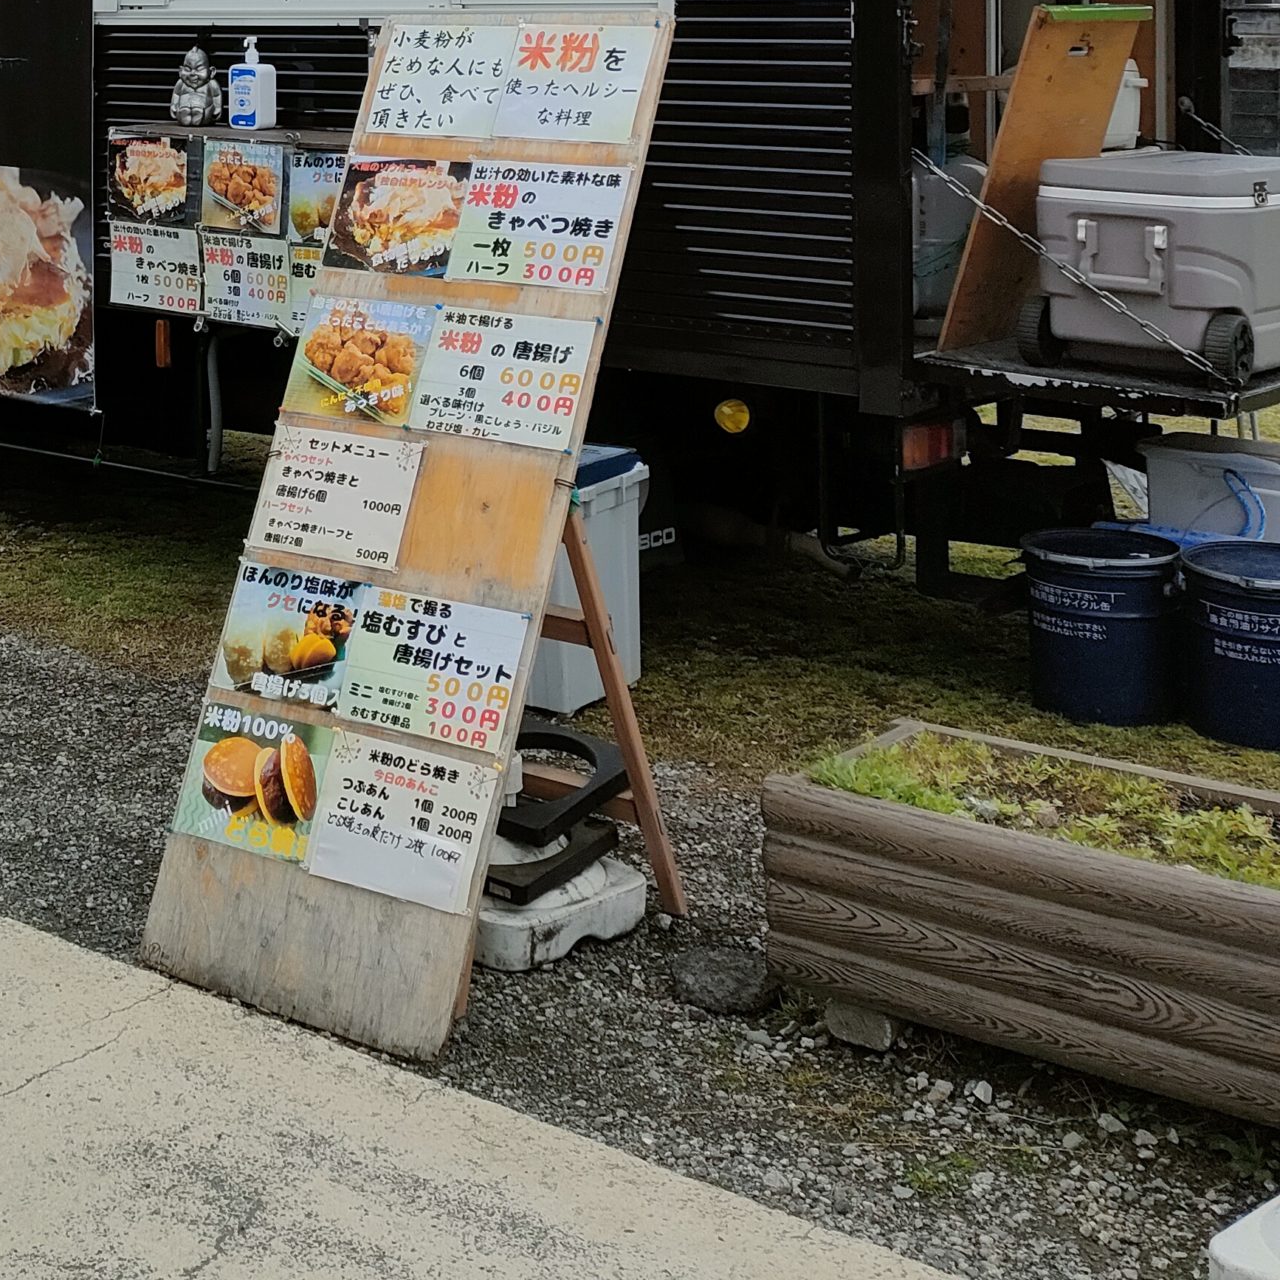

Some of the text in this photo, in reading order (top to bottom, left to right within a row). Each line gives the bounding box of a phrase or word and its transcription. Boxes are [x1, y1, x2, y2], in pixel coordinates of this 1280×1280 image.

[393, 29, 475, 49] 小麦粉が
[517, 31, 628, 73] 米粉を
[384, 56, 503, 78] だめな人にも
[505, 78, 638, 98] 使ったヘルシー
[371, 108, 454, 129] 頂きたい
[537, 107, 593, 127] な料理
[474, 166, 622, 188] 出汁の効いた素朴な味
[466, 182, 537, 209] 米粉の
[487, 210, 615, 239] きゃべつ焼き
[112, 234, 155, 255] 米粉の
[473, 238, 605, 266] 一枚 500円
[135, 257, 198, 277] きゃべつ焼き
[205, 246, 284, 271] 米粉の唐揚げ
[136, 274, 199, 293] 1枚 500円
[223, 269, 288, 291] 6個 600円
[466, 261, 596, 287] ハーフ 300円
[127, 291, 197, 311] ハーフ 300円
[227, 285, 286, 304] 3個 400円
[443, 311, 514, 330] 米油で揚げる
[437, 329, 574, 364] 米粉の唐揚げ
[459, 365, 582, 396] 6個 600円
[420, 394, 485, 413] 選べる味付け
[457, 386, 575, 417] 3個 400円
[425, 420, 501, 438] わさび塩・カレー
[309, 438, 390, 459] セットメニュー
[281, 465, 360, 488] きゃべつ焼きと
[261, 500, 313, 516] ハーフセット
[275, 484, 402, 516] 唐揚げ6個 1000円
[268, 517, 354, 541] きゃべつ焼きハーフと
[263, 532, 390, 564] 唐揚げ2個 500円
[242, 565, 354, 600] ほんのり塩味が
[267, 591, 360, 624] クセになる！
[360, 609, 468, 649] 塩むすびと
[392, 643, 513, 684] 唐揚げセット
[381, 697, 412, 711] 唐揚げ2個
[425, 673, 511, 710] 500円
[348, 682, 501, 732] ミニ 塩むすび1個と 300円
[203, 705, 297, 745] 米粉100%
[350, 705, 488, 750] おむすび単品 100円
[368, 749, 461, 784] 米粉のどら焼き
[373, 768, 440, 797] 今日のあんこ
[342, 777, 478, 826] つぶあん 1個 200円
[198, 799, 233, 834] mini
[337, 796, 473, 845] こしあん 1個 200円
[326, 811, 462, 864] どら焼きの皮だけ 2枚 100円
